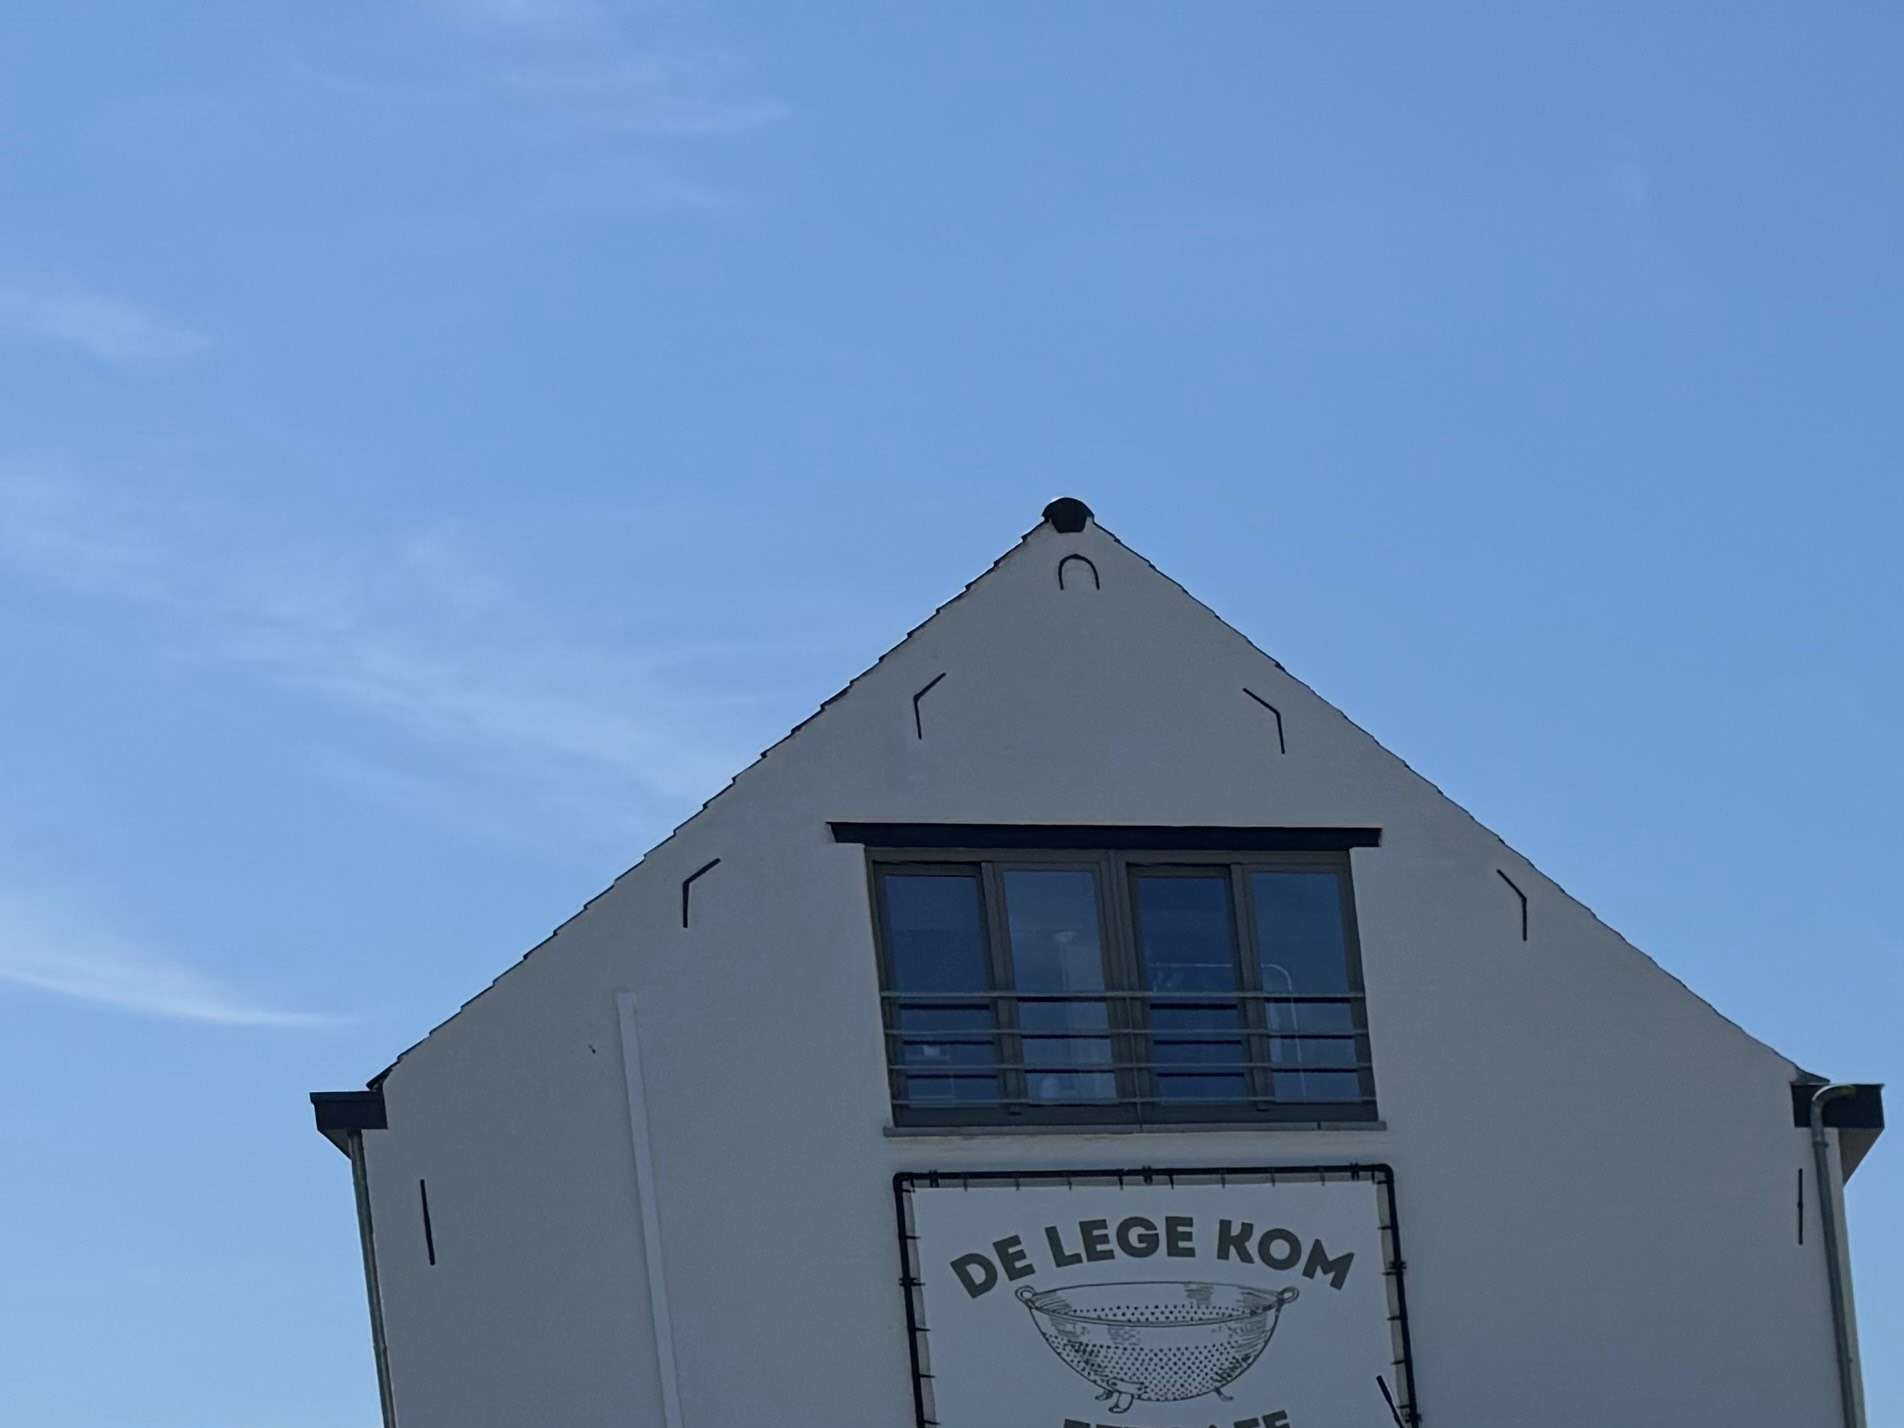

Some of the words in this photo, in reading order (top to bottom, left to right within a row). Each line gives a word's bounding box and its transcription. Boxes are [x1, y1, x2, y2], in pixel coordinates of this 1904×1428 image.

[950, 1234, 1036, 1299] DE
[1044, 1215, 1197, 1268] LEGE
[1216, 1218, 1355, 1290] KOM
